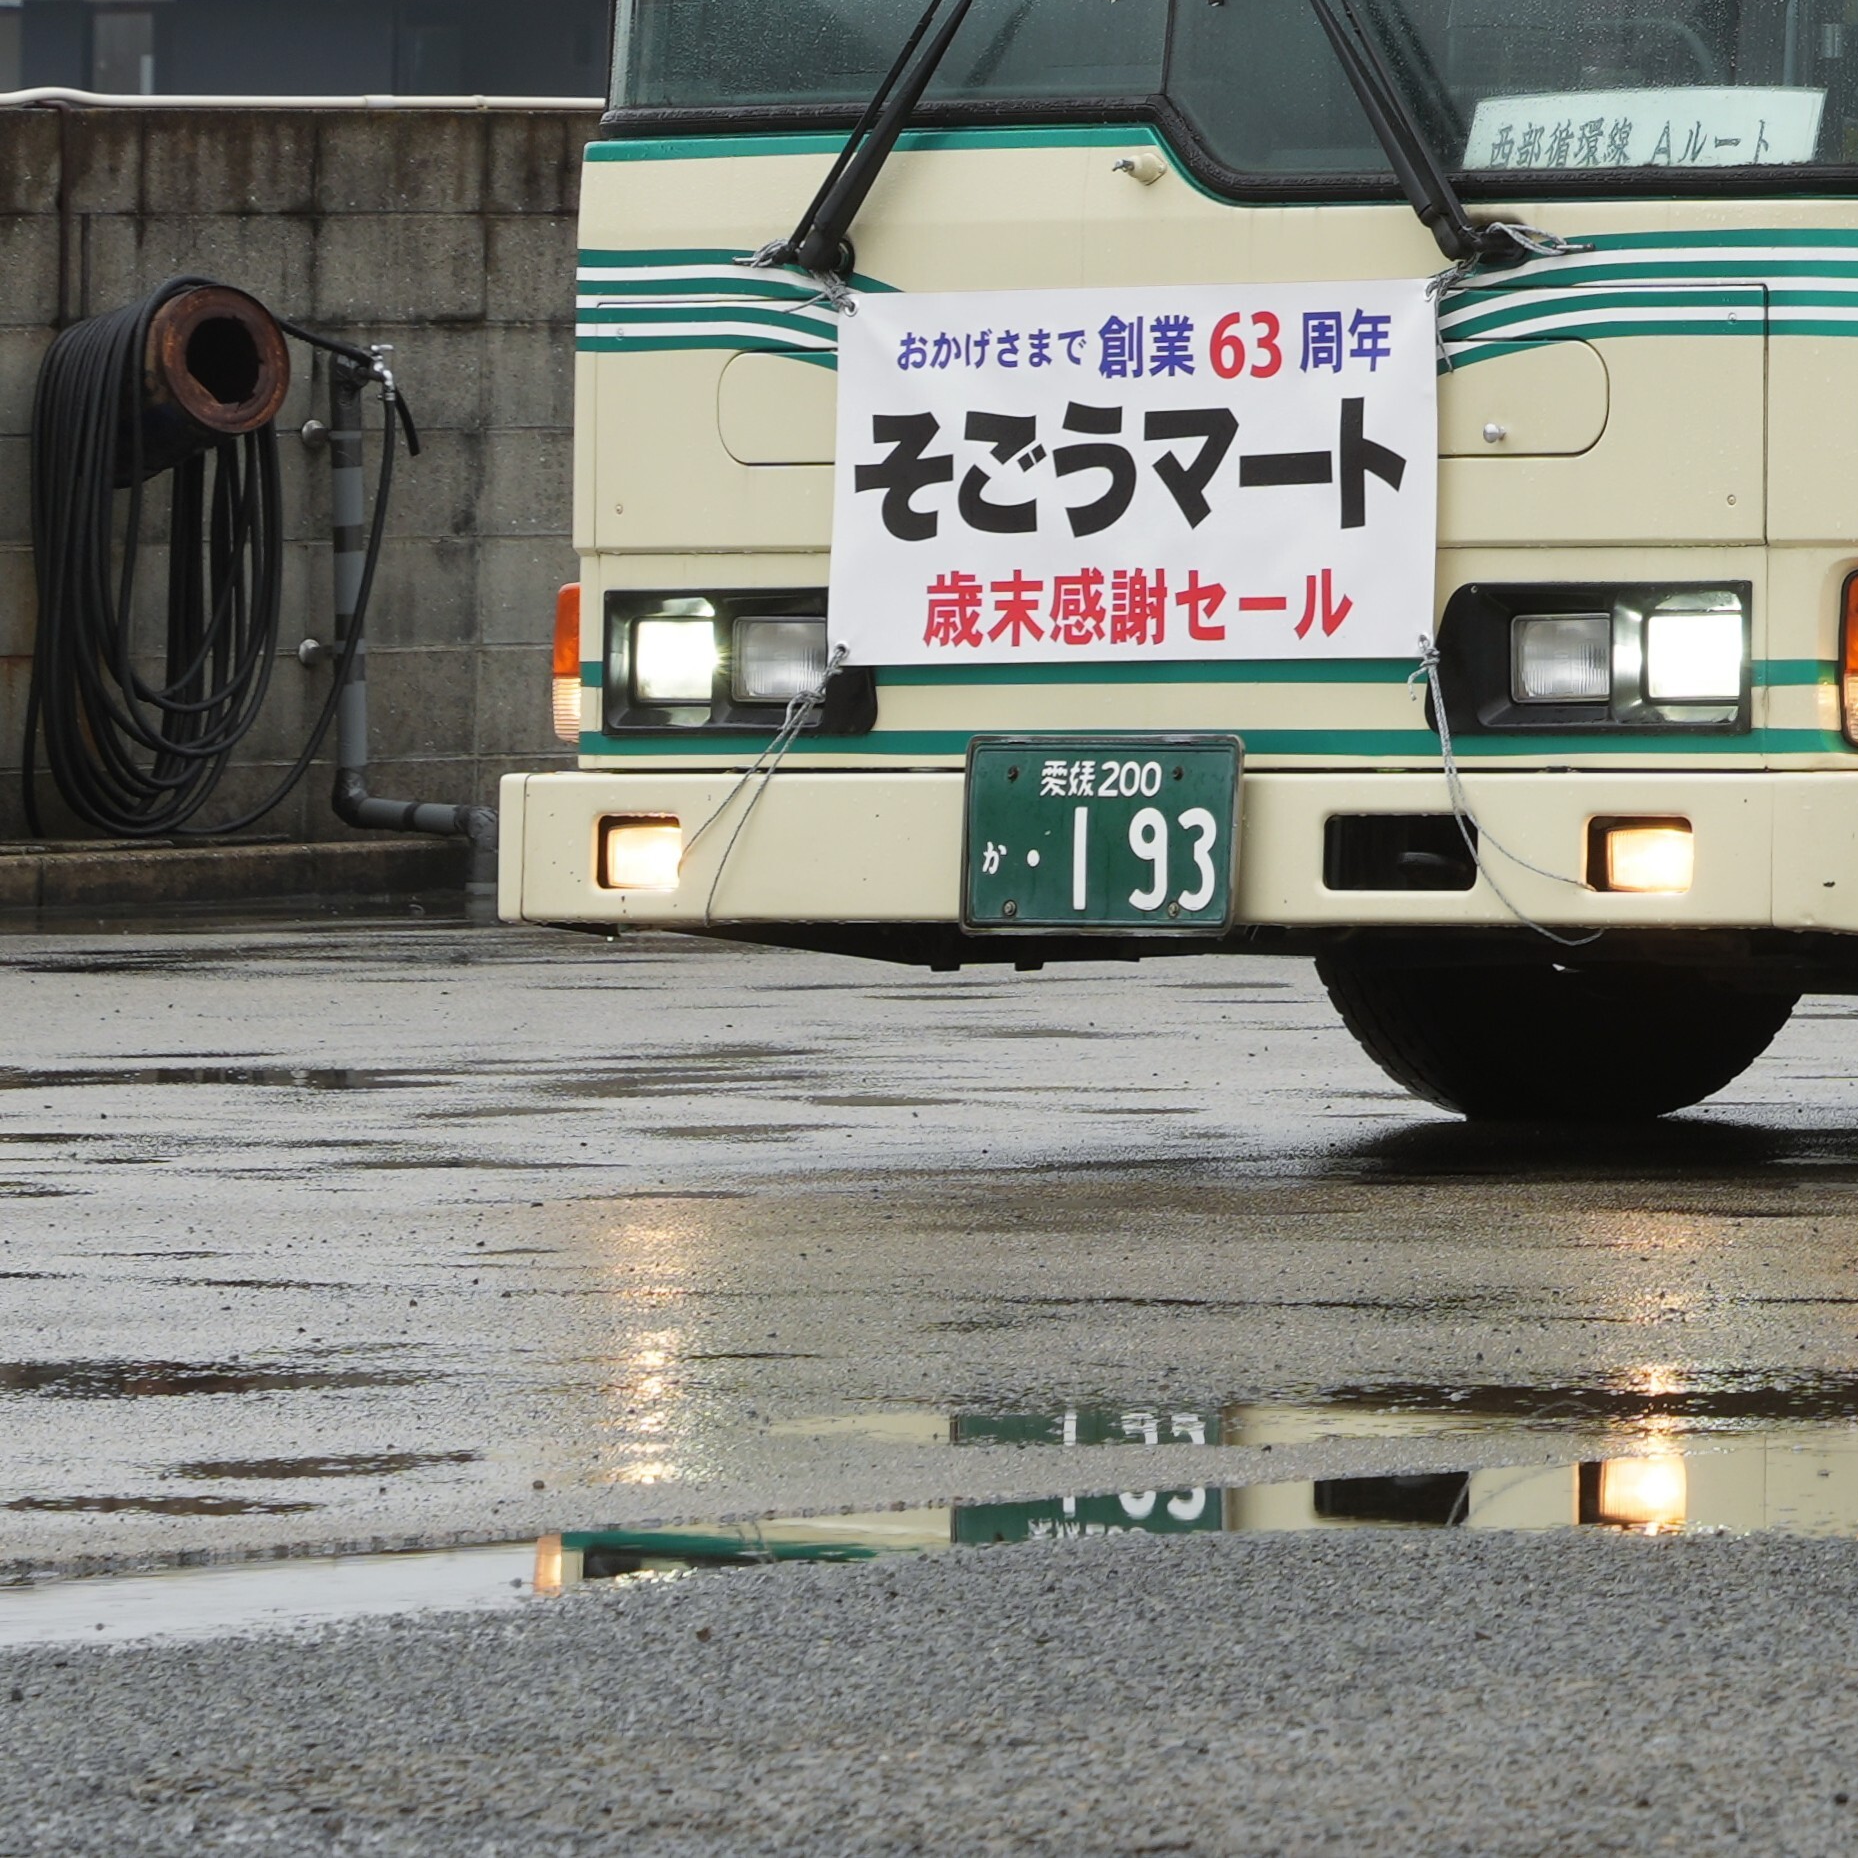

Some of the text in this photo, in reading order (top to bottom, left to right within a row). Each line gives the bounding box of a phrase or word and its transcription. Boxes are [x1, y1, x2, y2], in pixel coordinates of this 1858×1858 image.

[1489, 117, 1769, 169] 西部循環線 Aルート
[853, 397, 1407, 542] そごうマート
[923, 567, 1353, 648] 歳末感謝セール
